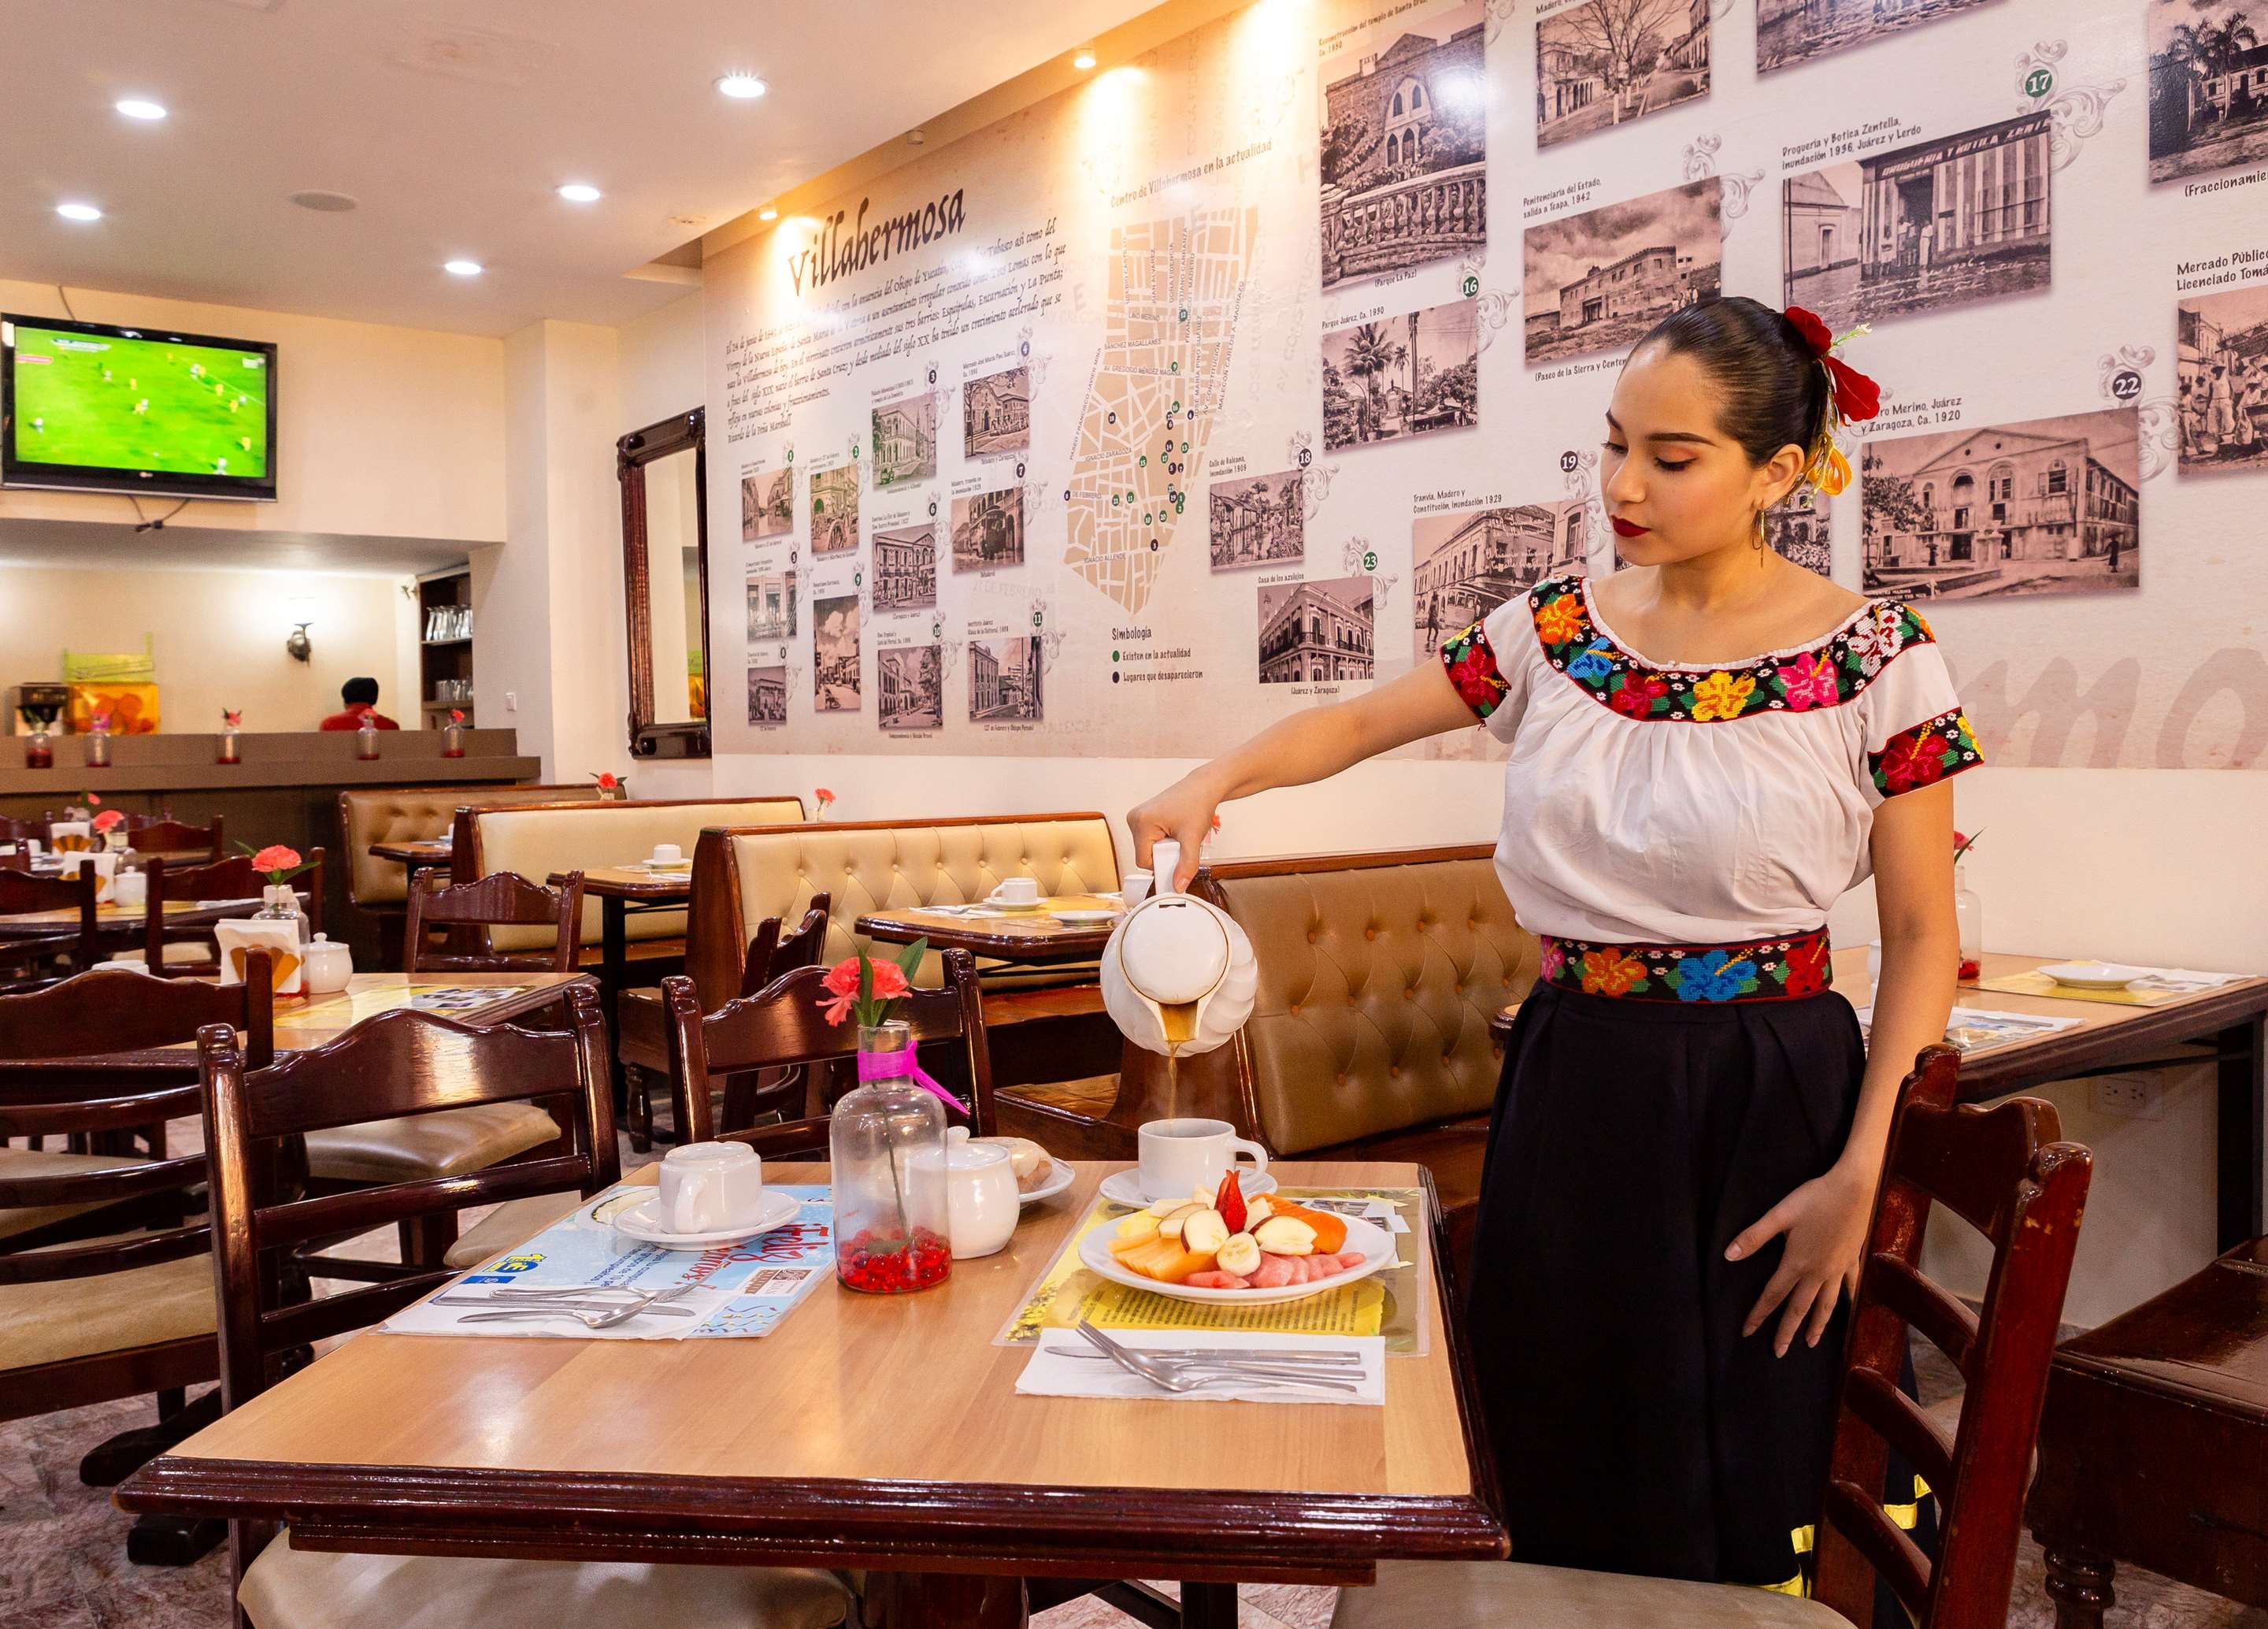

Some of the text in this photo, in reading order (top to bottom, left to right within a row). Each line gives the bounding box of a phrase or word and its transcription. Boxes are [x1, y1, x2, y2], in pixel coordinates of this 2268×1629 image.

[2029, 72, 2050, 93] 17
[1782, 117, 1901, 157] Droguería y Botica Zentella,
[1782, 151, 1826, 170] inundación
[1857, 135, 1886, 150] Juárez
[1888, 134, 1894, 143] y
[1897, 125, 1922, 139] Lerdo
[1139, 185, 1147, 198] de
[1203, 163, 1214, 174] en
[1216, 156, 1224, 170] la
[1226, 137, 1272, 166] actualidad
[1566, 183, 1576, 194] del
[1523, 208, 1542, 219] salida
[1572, 191, 1591, 205] 1942
[1026, 228, 1043, 243] como
[1045, 217, 1057, 236] del
[788, 187, 966, 297] Villahermosa
[1032, 253, 1043, 265] con
[1046, 243, 1052, 260] lo
[1054, 244, 1066, 265] que
[2177, 256, 2229, 276] Mercado
[1374, 269, 1417, 288] (Parque La Paz)
[2177, 263, 2268, 291] Licenciado Tomá
[884, 279, 893, 295] del
[1017, 282, 1026, 300] y
[1028, 277, 1037, 289] La
[1464, 280, 1477, 295] 16
[917, 334, 930, 347] XX
[1040, 297, 1053, 317] que
[1054, 292, 1062, 304] se
[1536, 372, 1555, 382] (Paseo
[1566, 367, 1572, 376] la
[1574, 365, 1594, 375] Sierra
[2116, 377, 2140, 395] 22
[1892, 402, 1928, 415] Merino,
[1931, 397, 1962, 409] Juárez
[1861, 410, 1961, 435] y Zaragoza, Ca. 1920
[1299, 451, 1311, 465] 18
[1562, 455, 1576, 469] 19
[1437, 489, 1460, 500] Madero
[1451, 497, 1484, 510] inundación
[1485, 494, 1502, 505] 1929
[1365, 555, 1377, 568] 23
[1284, 573, 1304, 582] azulejos
[1112, 625, 1151, 640] Simbología
[1123, 651, 1143, 661] Existen
[1153, 649, 1158, 659] la
[1160, 648, 1191, 659] actualidad
[1123, 670, 1203, 683] Lugares que desaparecieron
